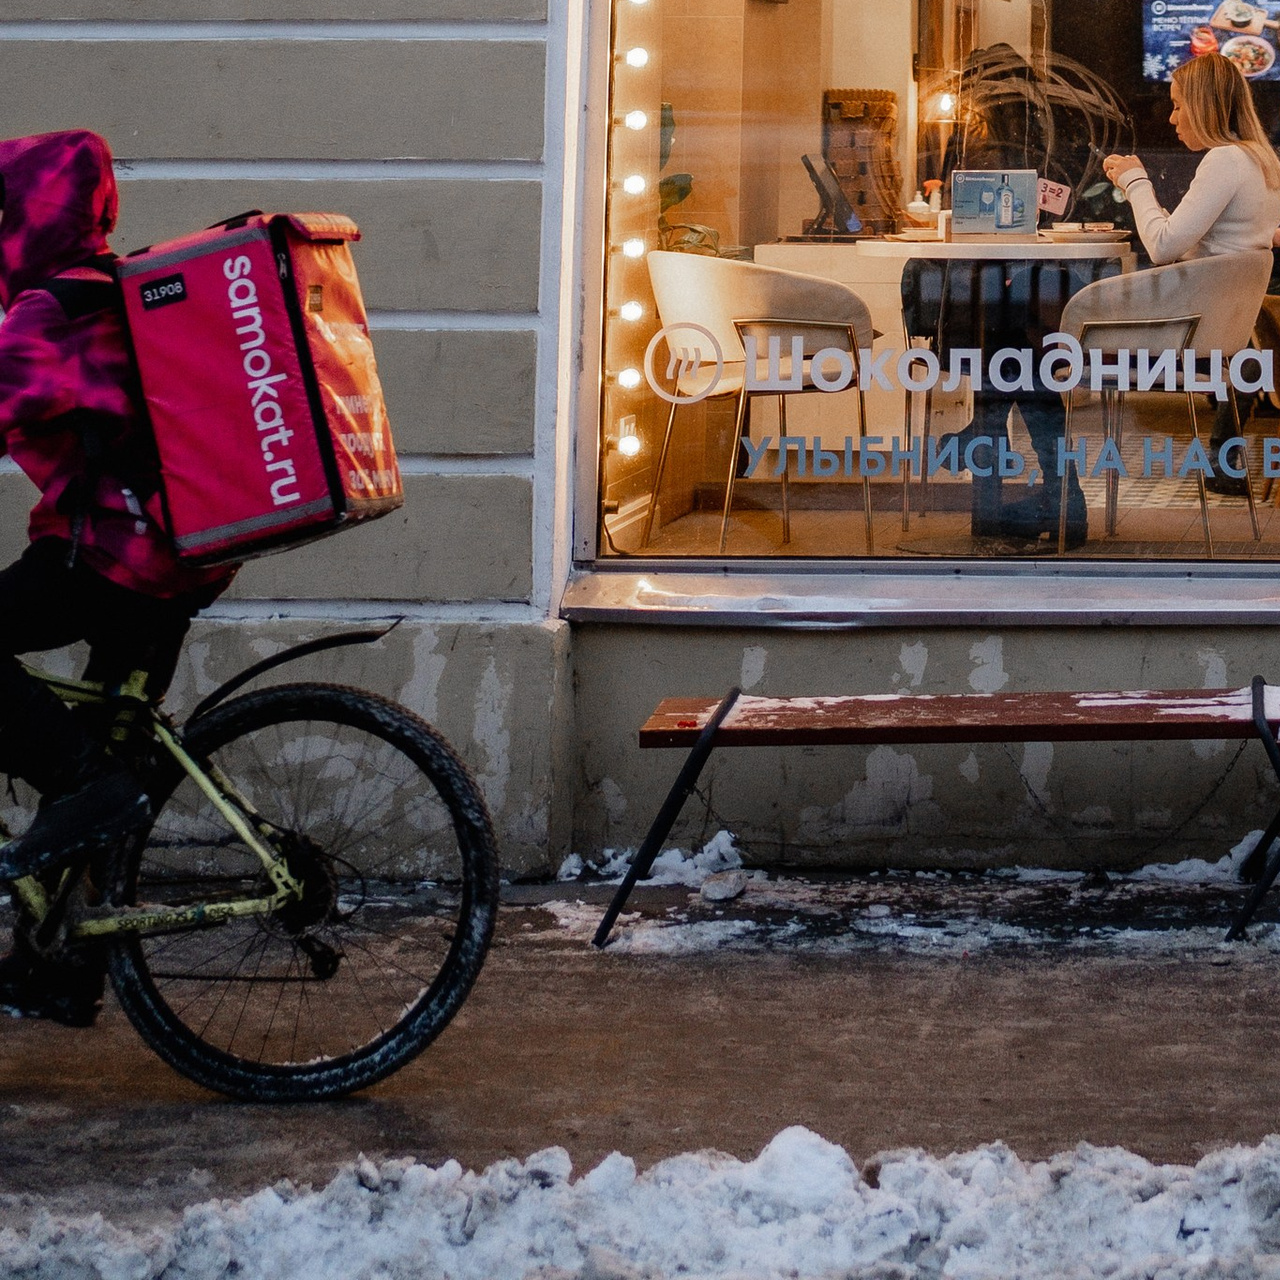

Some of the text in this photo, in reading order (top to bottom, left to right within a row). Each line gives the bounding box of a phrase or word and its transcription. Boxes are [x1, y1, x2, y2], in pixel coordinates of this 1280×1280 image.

[144, 282, 183, 302] 31908
[223, 255, 300, 506] samokat.ru
[743, 332, 1275, 402] Шоколадница
[740, 435, 1040, 487] УЛЫБНИСЬ,
[1057, 436, 1129, 478] НА
[1143, 436, 1247, 479] НАС
